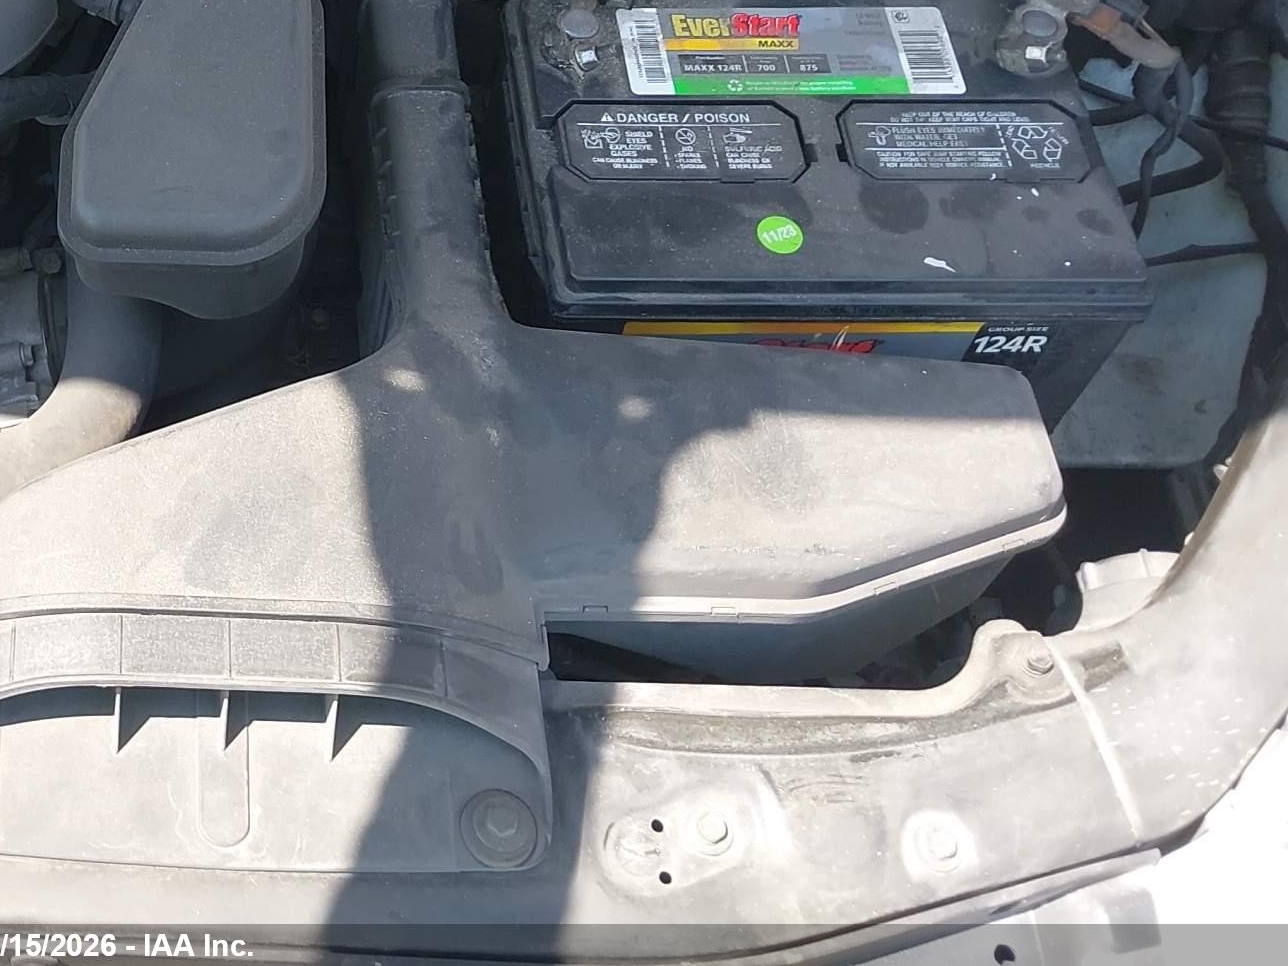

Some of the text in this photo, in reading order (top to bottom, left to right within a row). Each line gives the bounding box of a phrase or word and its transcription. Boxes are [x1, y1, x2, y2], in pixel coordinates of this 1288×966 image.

[670, 12, 801, 38] EverStart
[757, 40, 794, 48] MAXX
[684, 64, 743, 72] MAXX 124R
[757, 64, 776, 72] 700
[617, 113, 678, 123] DANGER
[694, 113, 750, 123] POISON
[762, 224, 797, 243] 11/23
[974, 335, 1048, 353] 124R
